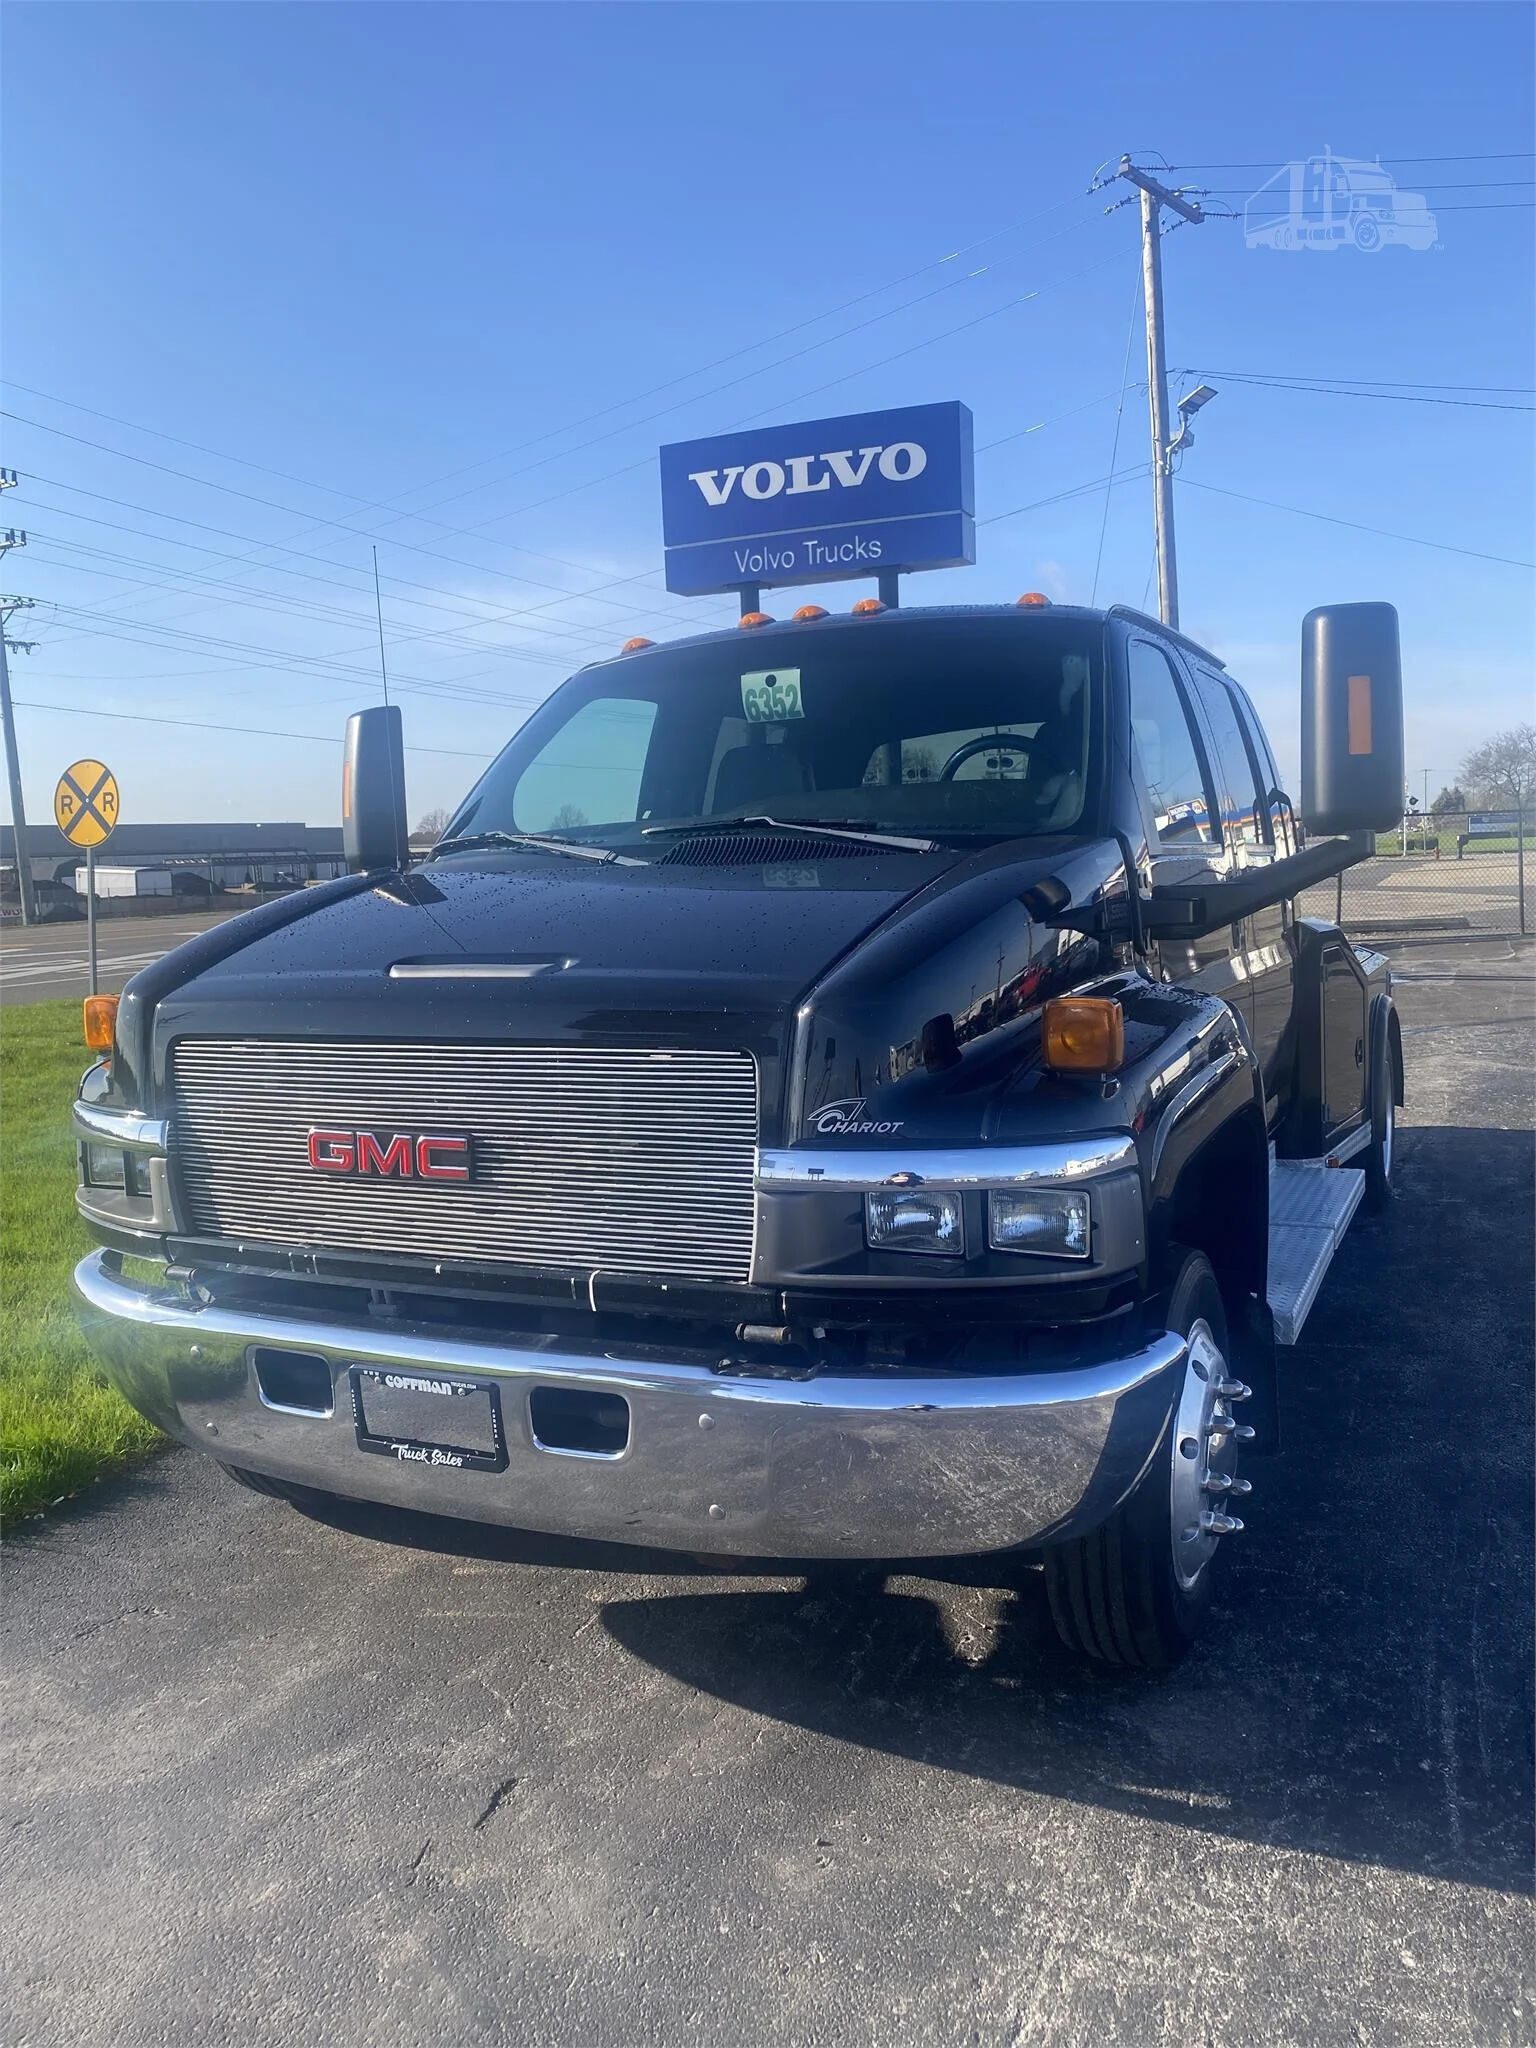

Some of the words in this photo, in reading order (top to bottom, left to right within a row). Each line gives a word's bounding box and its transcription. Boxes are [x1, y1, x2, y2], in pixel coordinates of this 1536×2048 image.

[688, 442, 927, 506] VOLVO
[734, 548, 795, 573] Volvo
[803, 536, 882, 566] Trucks
[745, 684, 802, 721] 6352
[61, 795, 73, 815] R
[103, 791, 114, 812] R
[817, 1112, 904, 1134] CHARIOT
[308, 1126, 470, 1180] GMC
[385, 1375, 452, 1395] COFFMAN
[391, 1444, 430, 1465] Truck
[431, 1449, 463, 1467] Sales
